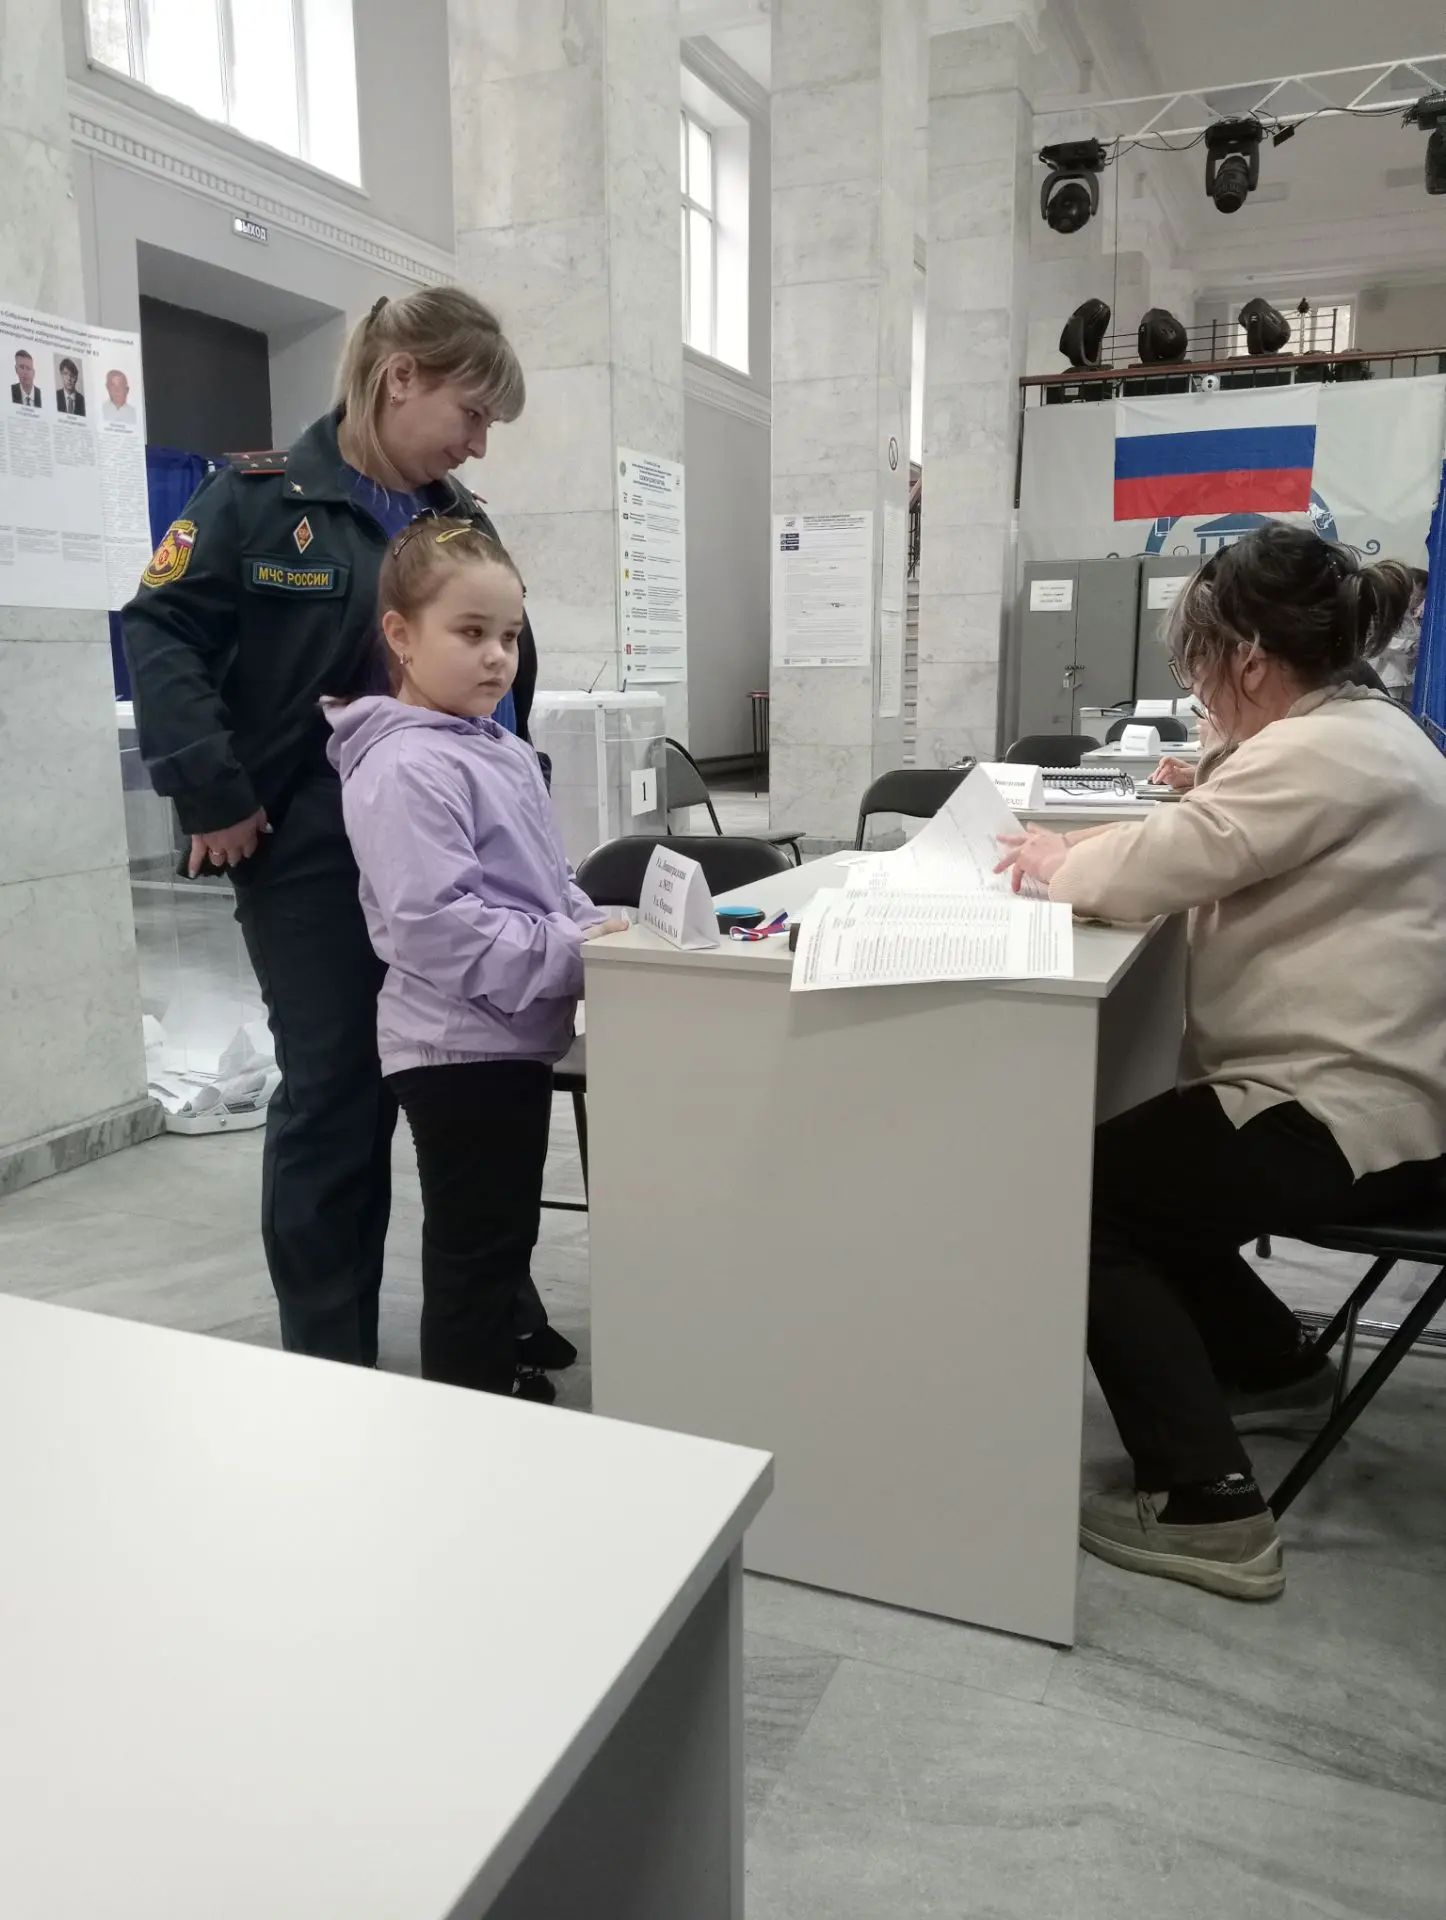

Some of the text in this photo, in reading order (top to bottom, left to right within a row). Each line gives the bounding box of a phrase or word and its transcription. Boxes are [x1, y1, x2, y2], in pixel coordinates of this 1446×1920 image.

[258, 566, 329, 587] МЧС РОССИИ
[642, 781, 647, 802] 1
